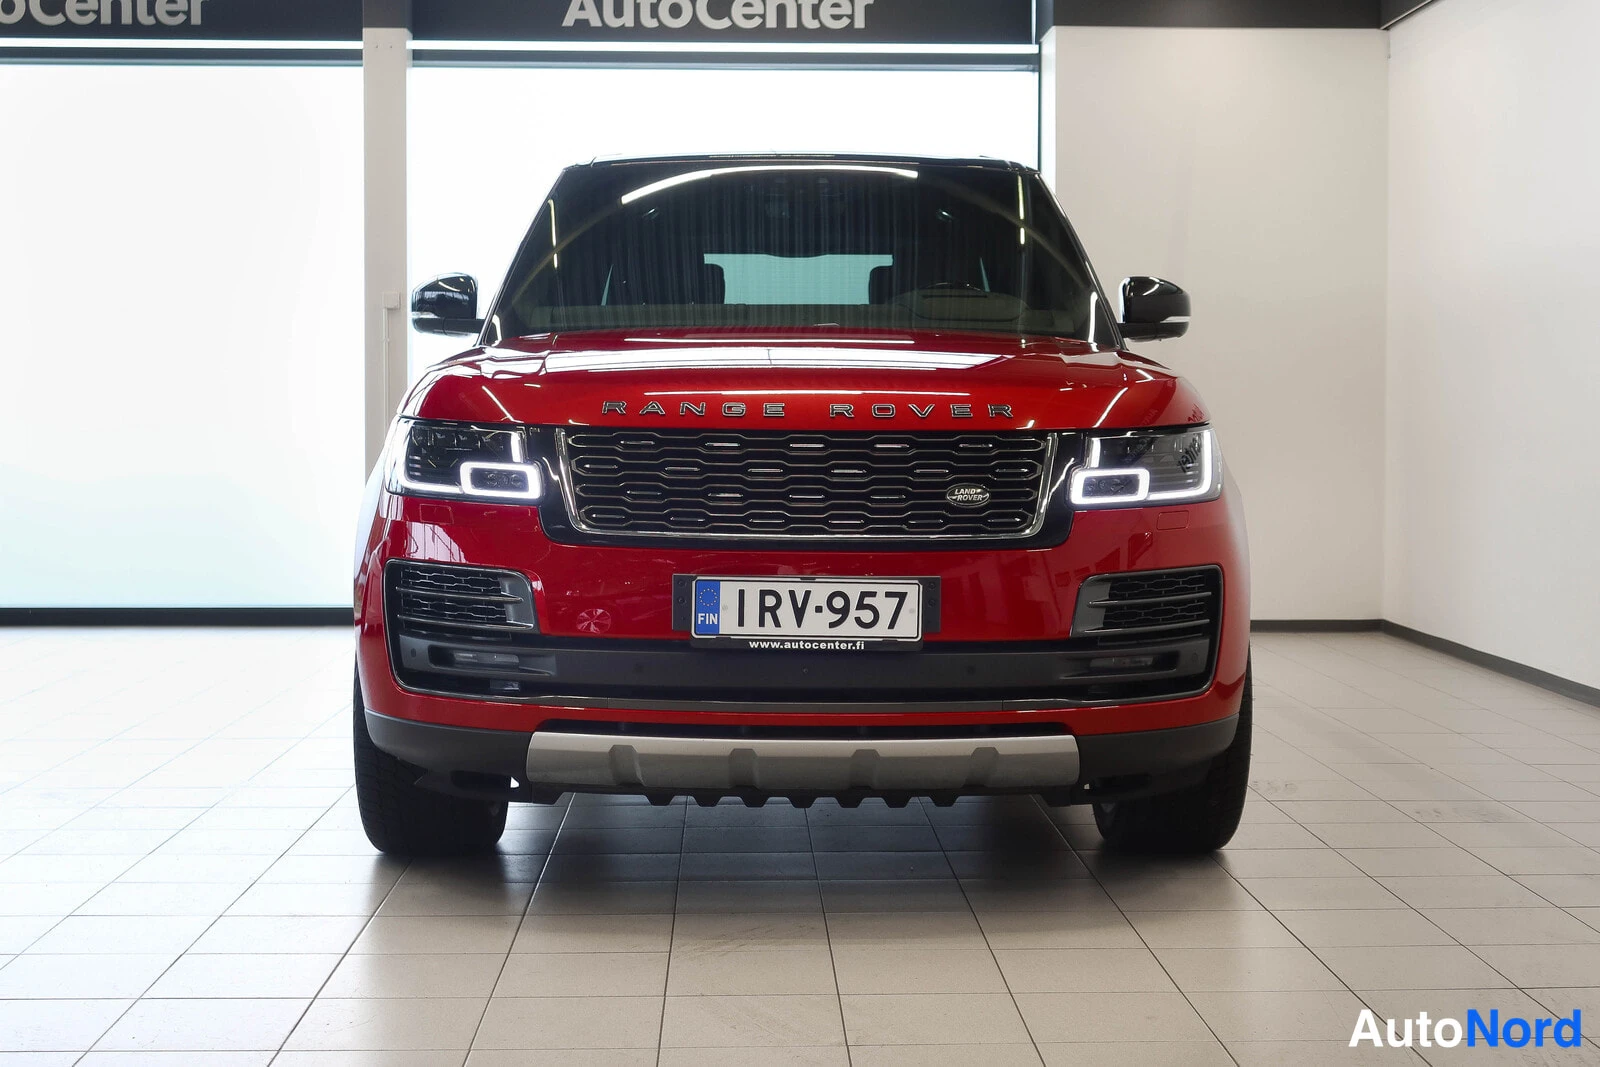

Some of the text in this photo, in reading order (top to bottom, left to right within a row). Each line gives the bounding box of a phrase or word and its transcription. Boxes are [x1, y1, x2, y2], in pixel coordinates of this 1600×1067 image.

[561, 0, 874, 30] AutoCenter
[601, 400, 1014, 419] RANGE ROVER
[697, 613, 718, 625] FIN
[749, 640, 865, 650] www.autocenter.fi
